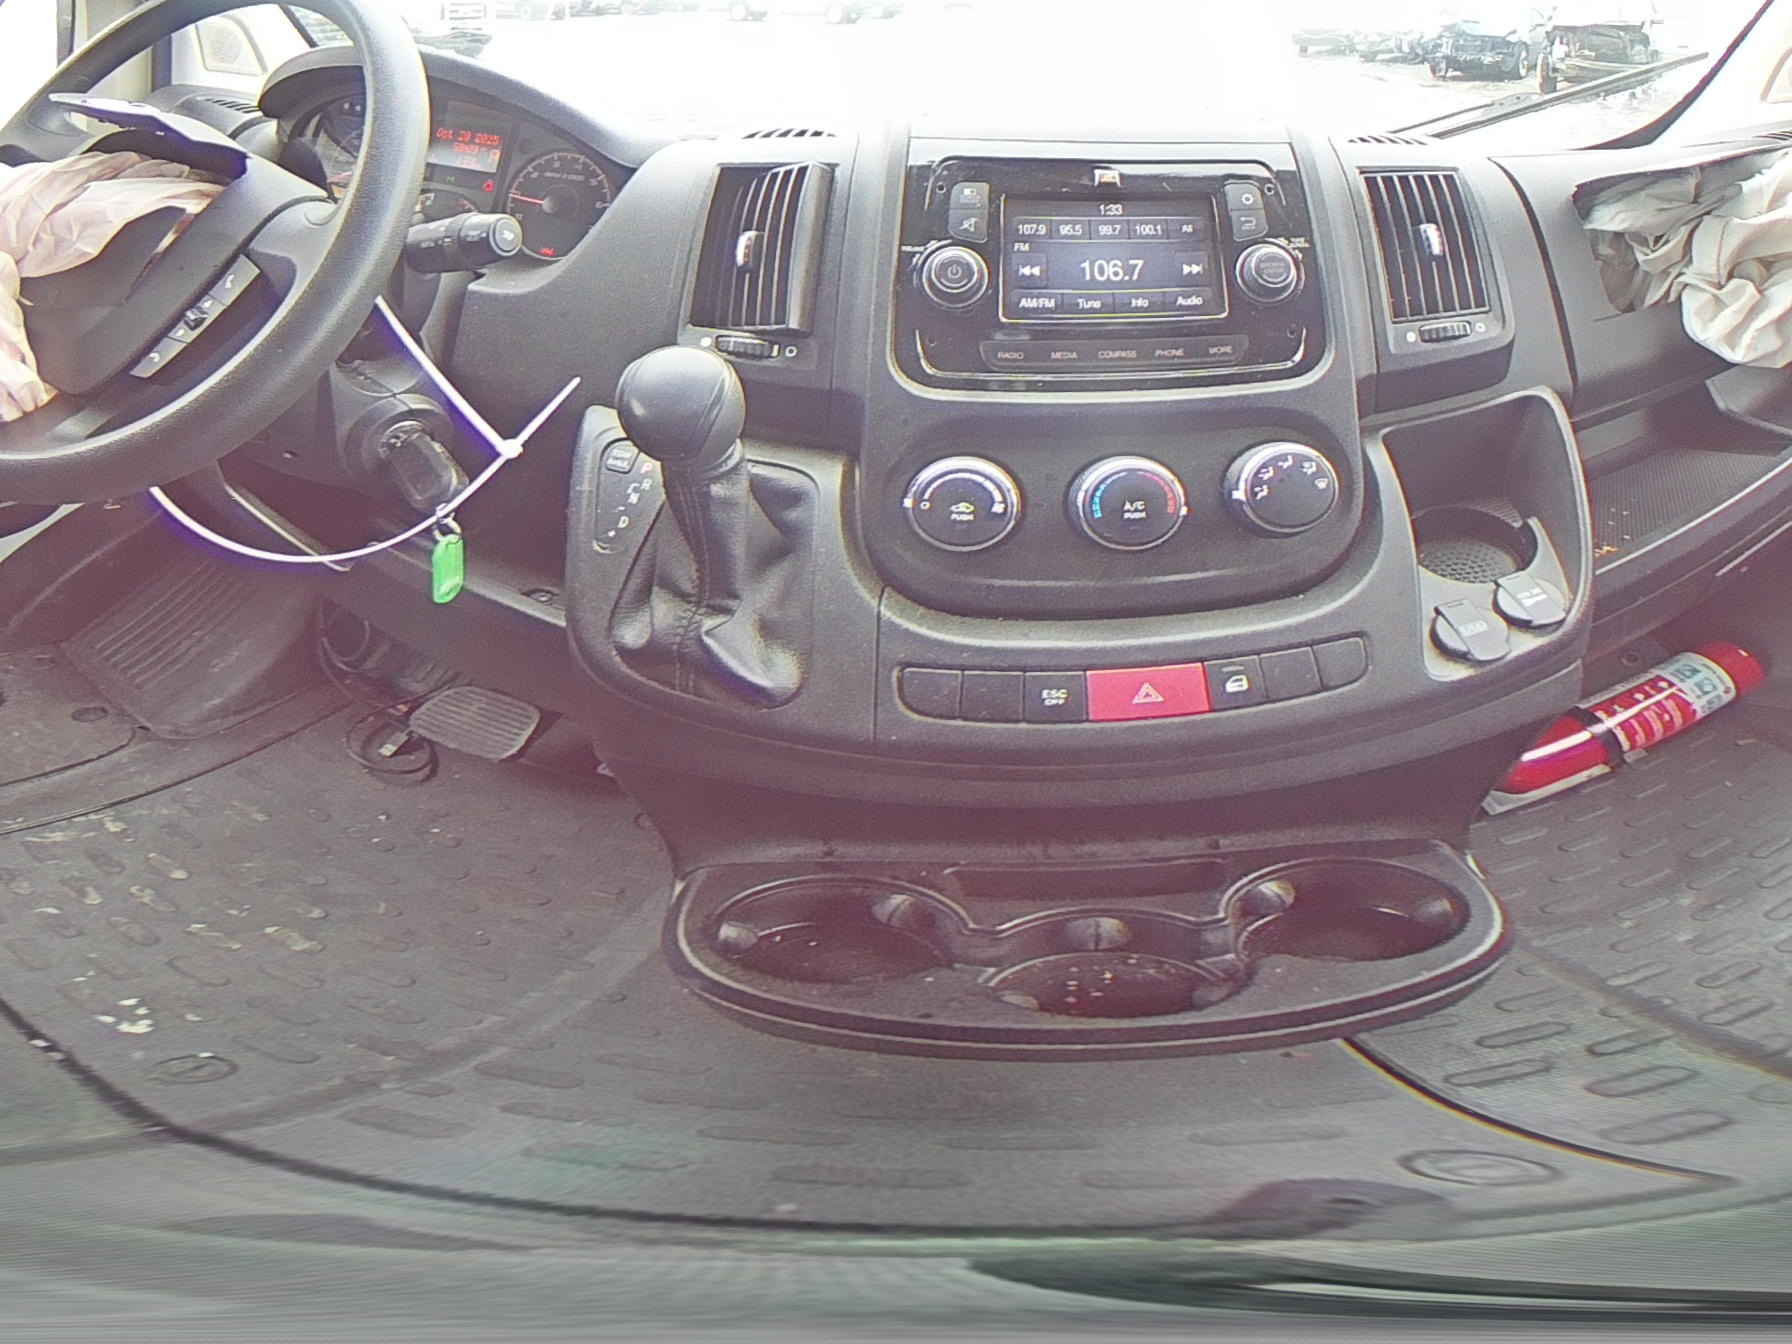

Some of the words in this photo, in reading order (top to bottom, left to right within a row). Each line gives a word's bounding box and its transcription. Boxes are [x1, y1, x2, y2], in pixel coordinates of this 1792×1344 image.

[1099, 204, 1123, 215] 1:33
[1013, 243, 1029, 252] FM
[1080, 259, 1144, 281] 106.7
[1076, 299, 1101, 309] Tune
[1131, 298, 1149, 308] Info
[1176, 296, 1203, 306] Audio
[997, 351, 1024, 360] RADIO
[1050, 351, 1078, 360] MEDIA
[640, 462, 653, 474] P
[641, 478, 652, 491] R
[618, 516, 629, 528] D
